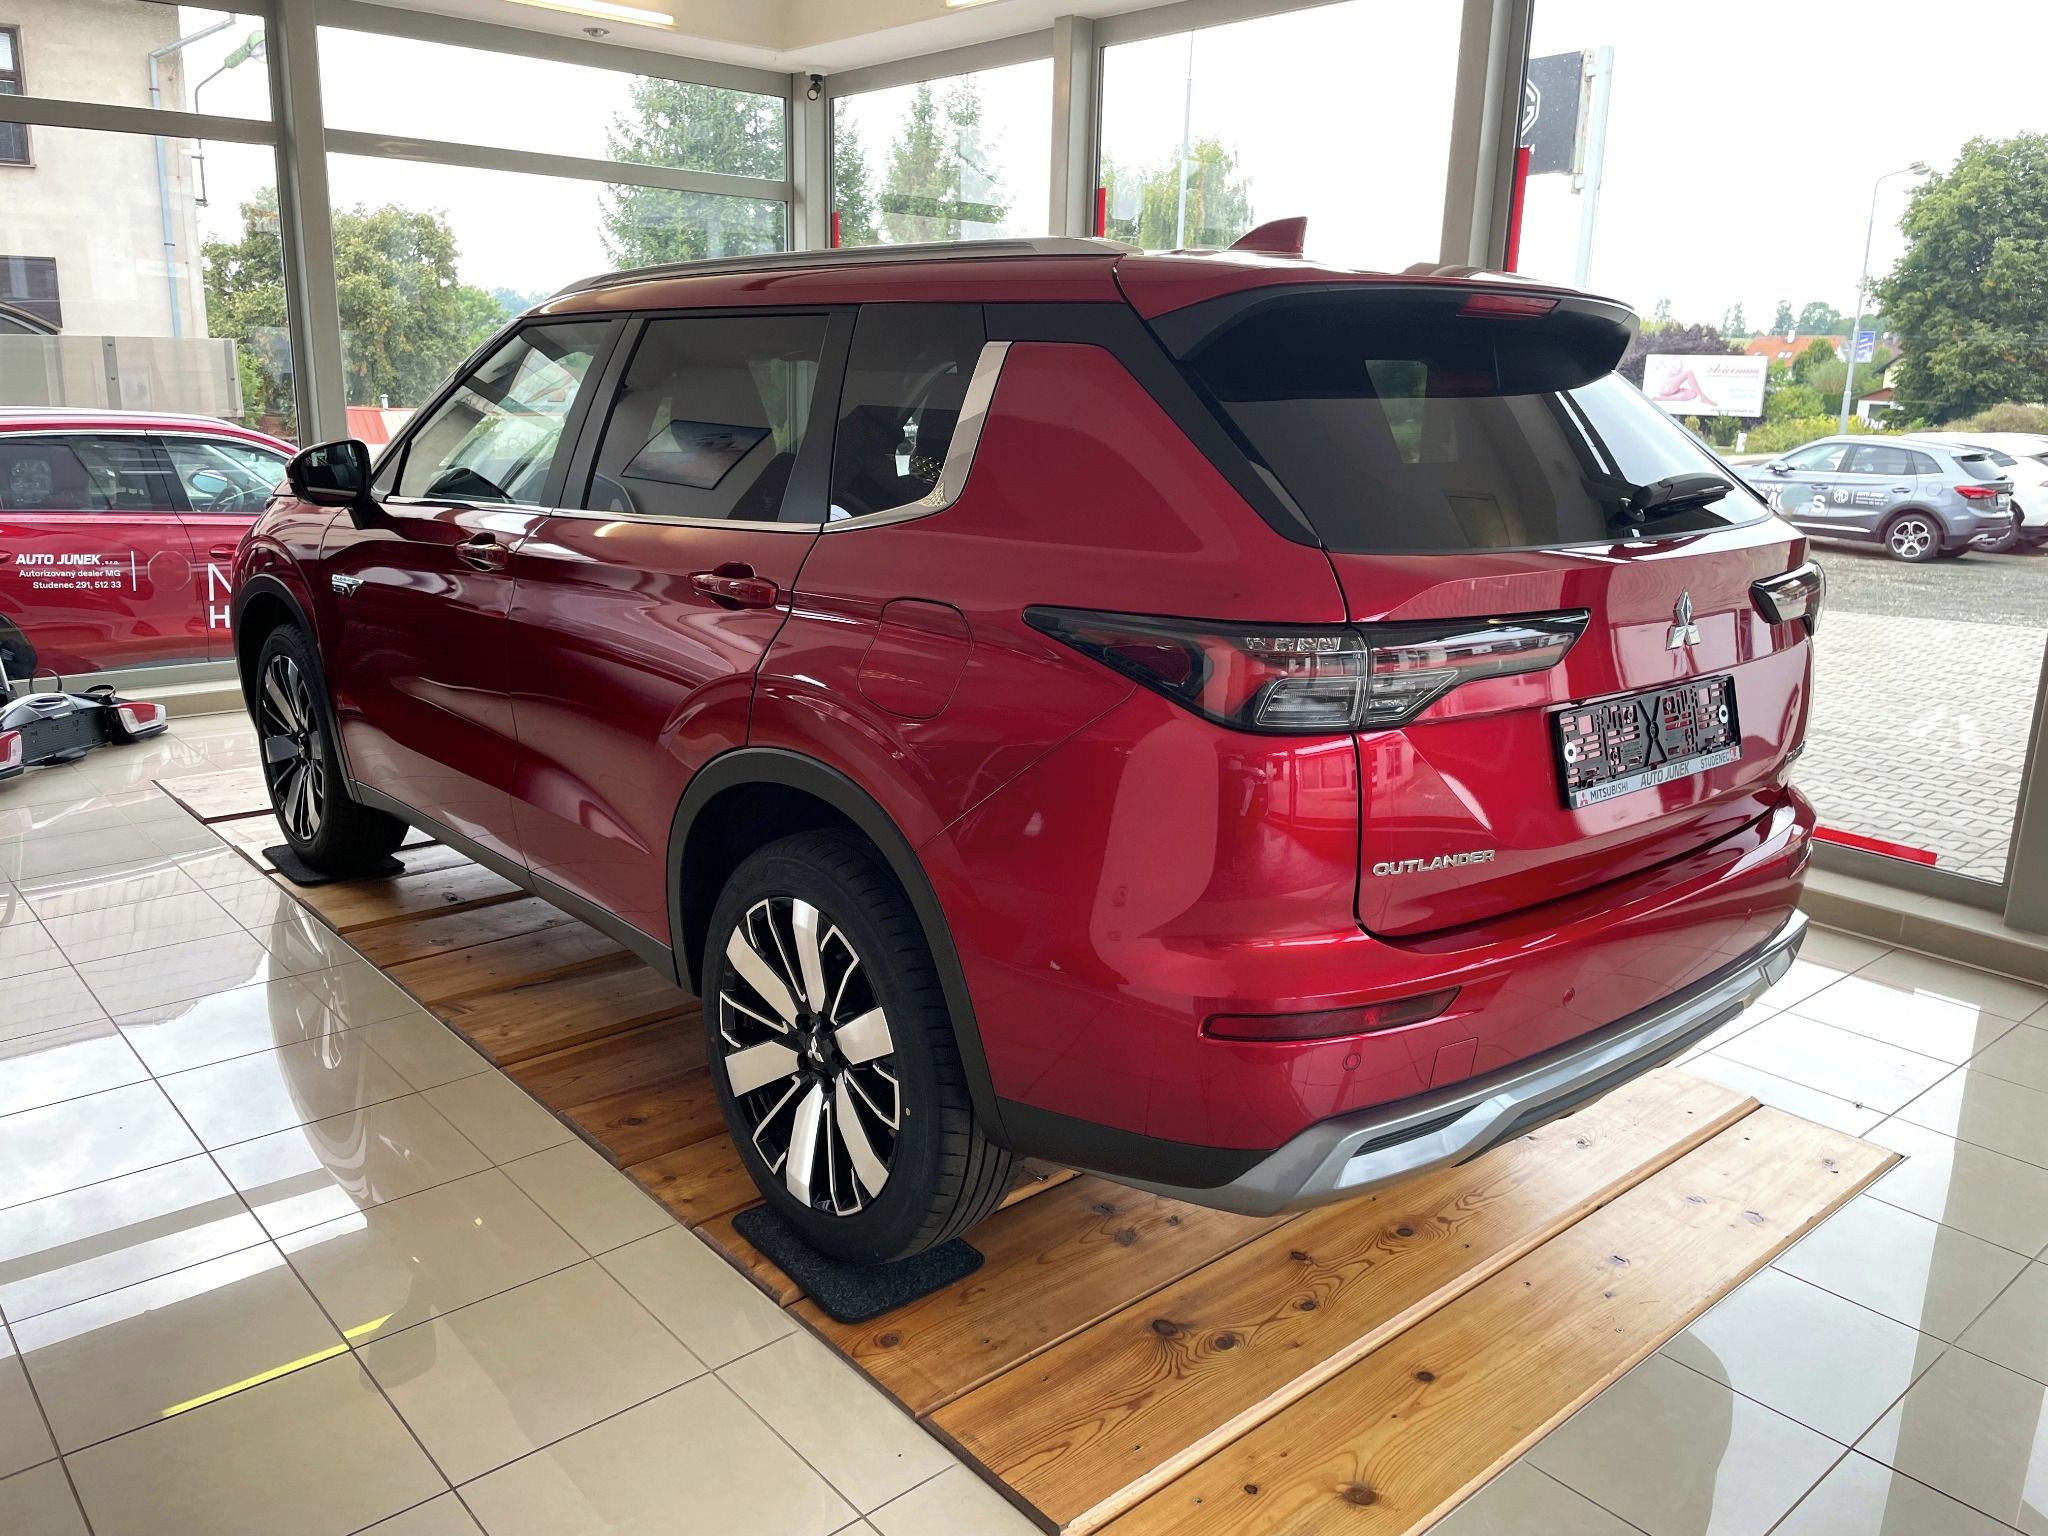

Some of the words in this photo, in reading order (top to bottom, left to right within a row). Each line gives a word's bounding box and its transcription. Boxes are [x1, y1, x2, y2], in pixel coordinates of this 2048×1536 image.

[15, 554, 55, 565] AUTO
[57, 553, 102, 565] JUNEK
[19, 569, 76, 579] Autorizovaný
[77, 569, 103, 578] dealer
[105, 569, 121, 577] MG
[32, 581, 75, 589] Studenec
[75, 581, 93, 590] 291,
[94, 581, 109, 589] 512
[110, 581, 122, 589] 33
[1590, 781, 1629, 801] MITSUBISHI
[1640, 769, 1664, 788] AUTO
[1665, 762, 1690, 781] JUNEK
[1700, 751, 1730, 769] STUDENEC
[1372, 849, 1496, 877] OUTLANDER
